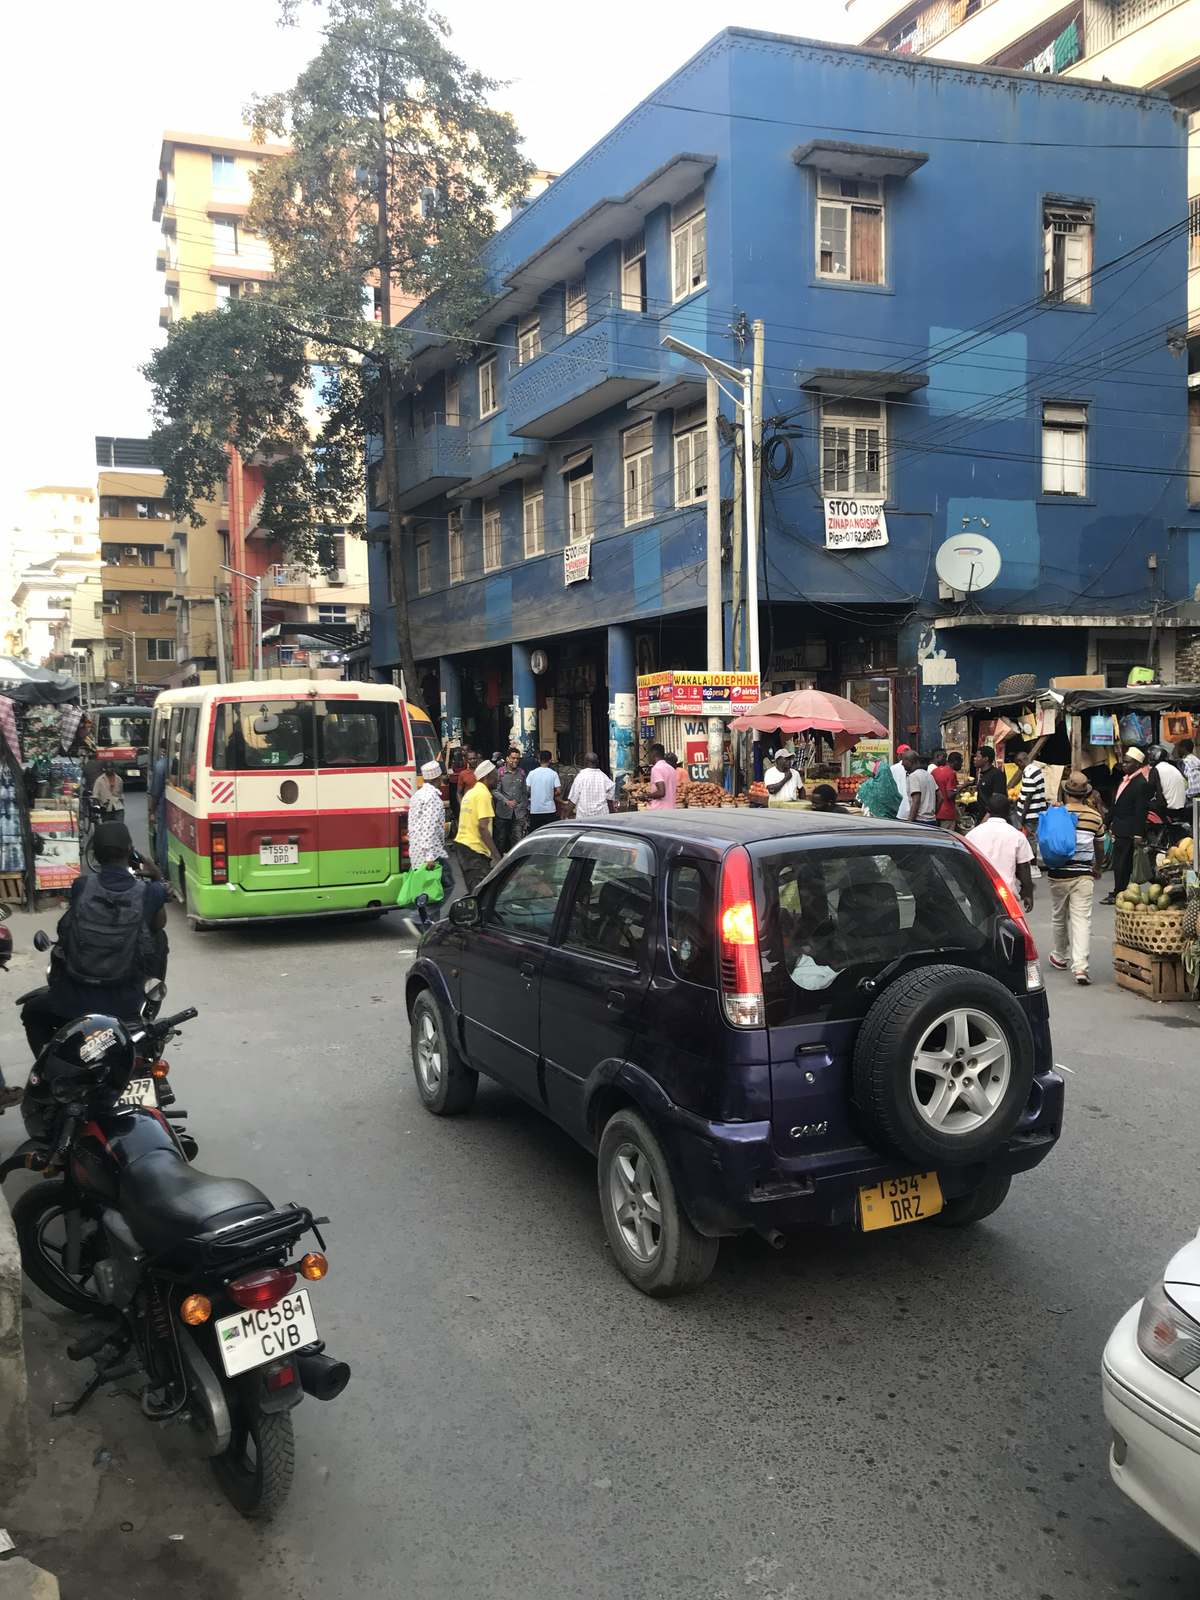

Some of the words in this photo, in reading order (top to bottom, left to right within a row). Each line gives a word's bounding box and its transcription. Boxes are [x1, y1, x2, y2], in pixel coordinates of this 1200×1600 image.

[829, 500, 858, 516] STOO
[673, 674, 708, 685] WAKALA
[709, 674, 759, 686] JOSEPHINE
[684, 722, 707, 736] WA
[124, 1080, 151, 1096] 977
[890, 1195, 924, 1222] DRZ
[240, 1294, 306, 1339] MC581
[261, 1323, 301, 1356] CVB
